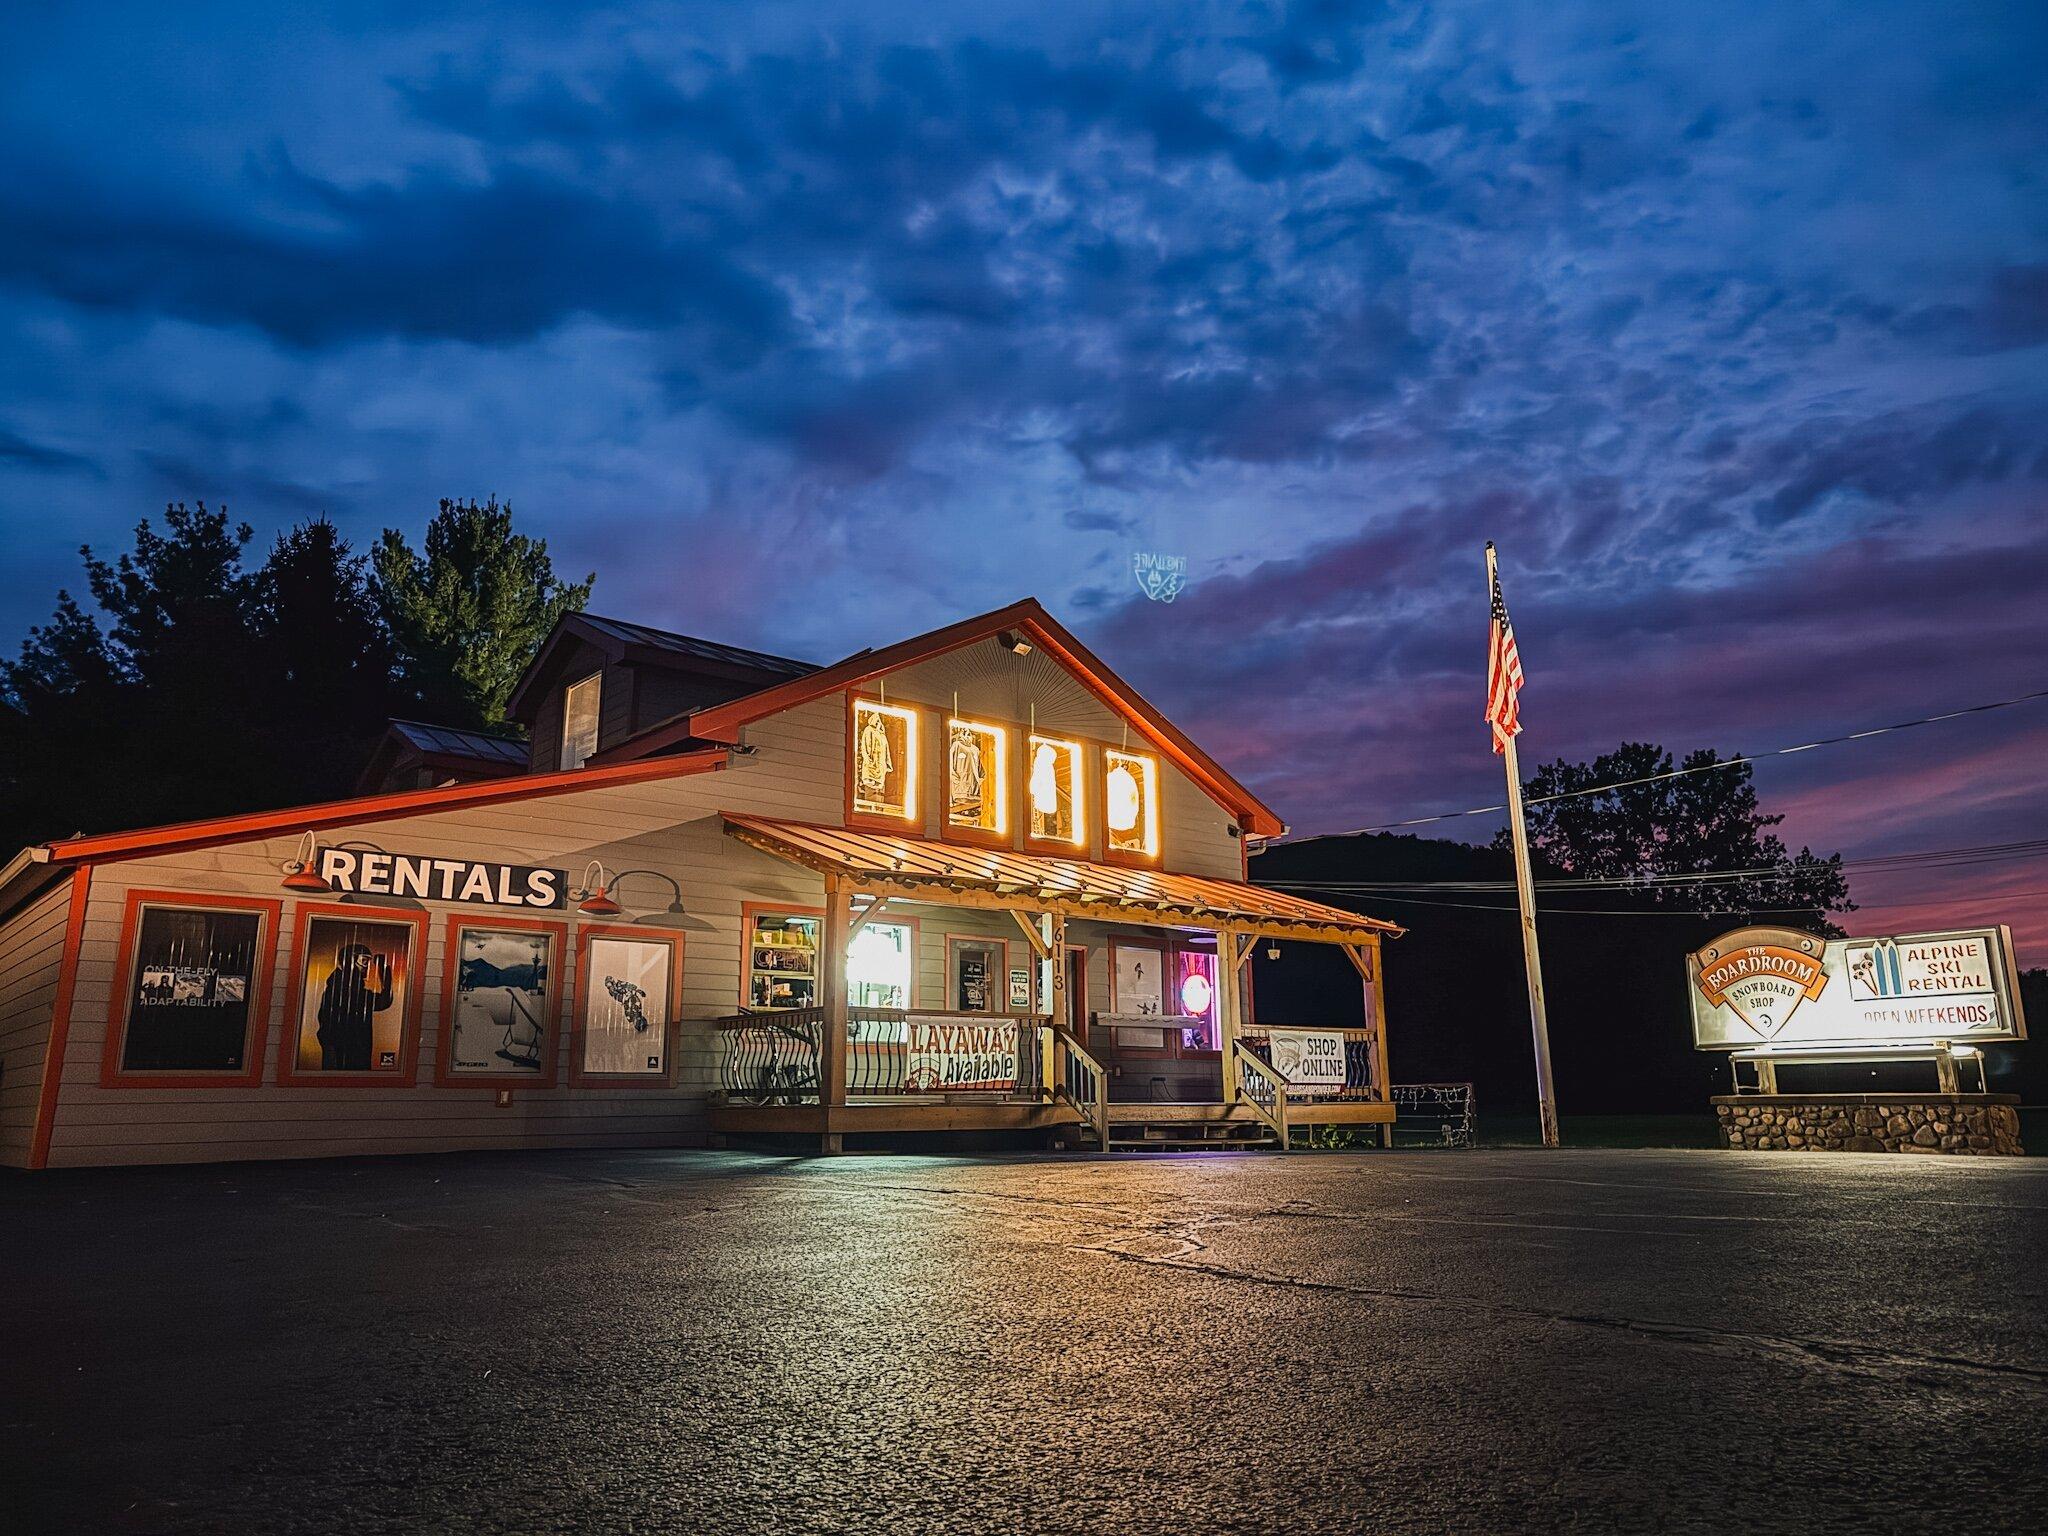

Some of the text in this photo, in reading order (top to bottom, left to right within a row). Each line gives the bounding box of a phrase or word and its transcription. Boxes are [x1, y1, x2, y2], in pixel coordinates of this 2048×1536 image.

[321, 850, 556, 907] RENTALS
[755, 949, 808, 971] OPEN
[1054, 927, 1063, 990] 6113
[1746, 947, 1766, 956] THE
[1908, 944, 1978, 962] ALPINE
[144, 965, 218, 976] ON-THE-FLY
[1707, 956, 1814, 990] BOARDROOM
[1927, 960, 1961, 975] SKI
[1732, 982, 1795, 1001] SNOWBOARD
[1908, 975, 1986, 991] RENTAL
[140, 997, 227, 1008] ADAPTABILITY
[1750, 998, 1774, 1009] SHOP
[1864, 1004, 1988, 1024] OPEN WEEKENDS
[910, 1025, 1016, 1054] LAYAWAY
[1307, 1038, 1337, 1056] SHOP
[944, 1054, 1013, 1083] Available
[1302, 1059, 1344, 1077] ONLINE
